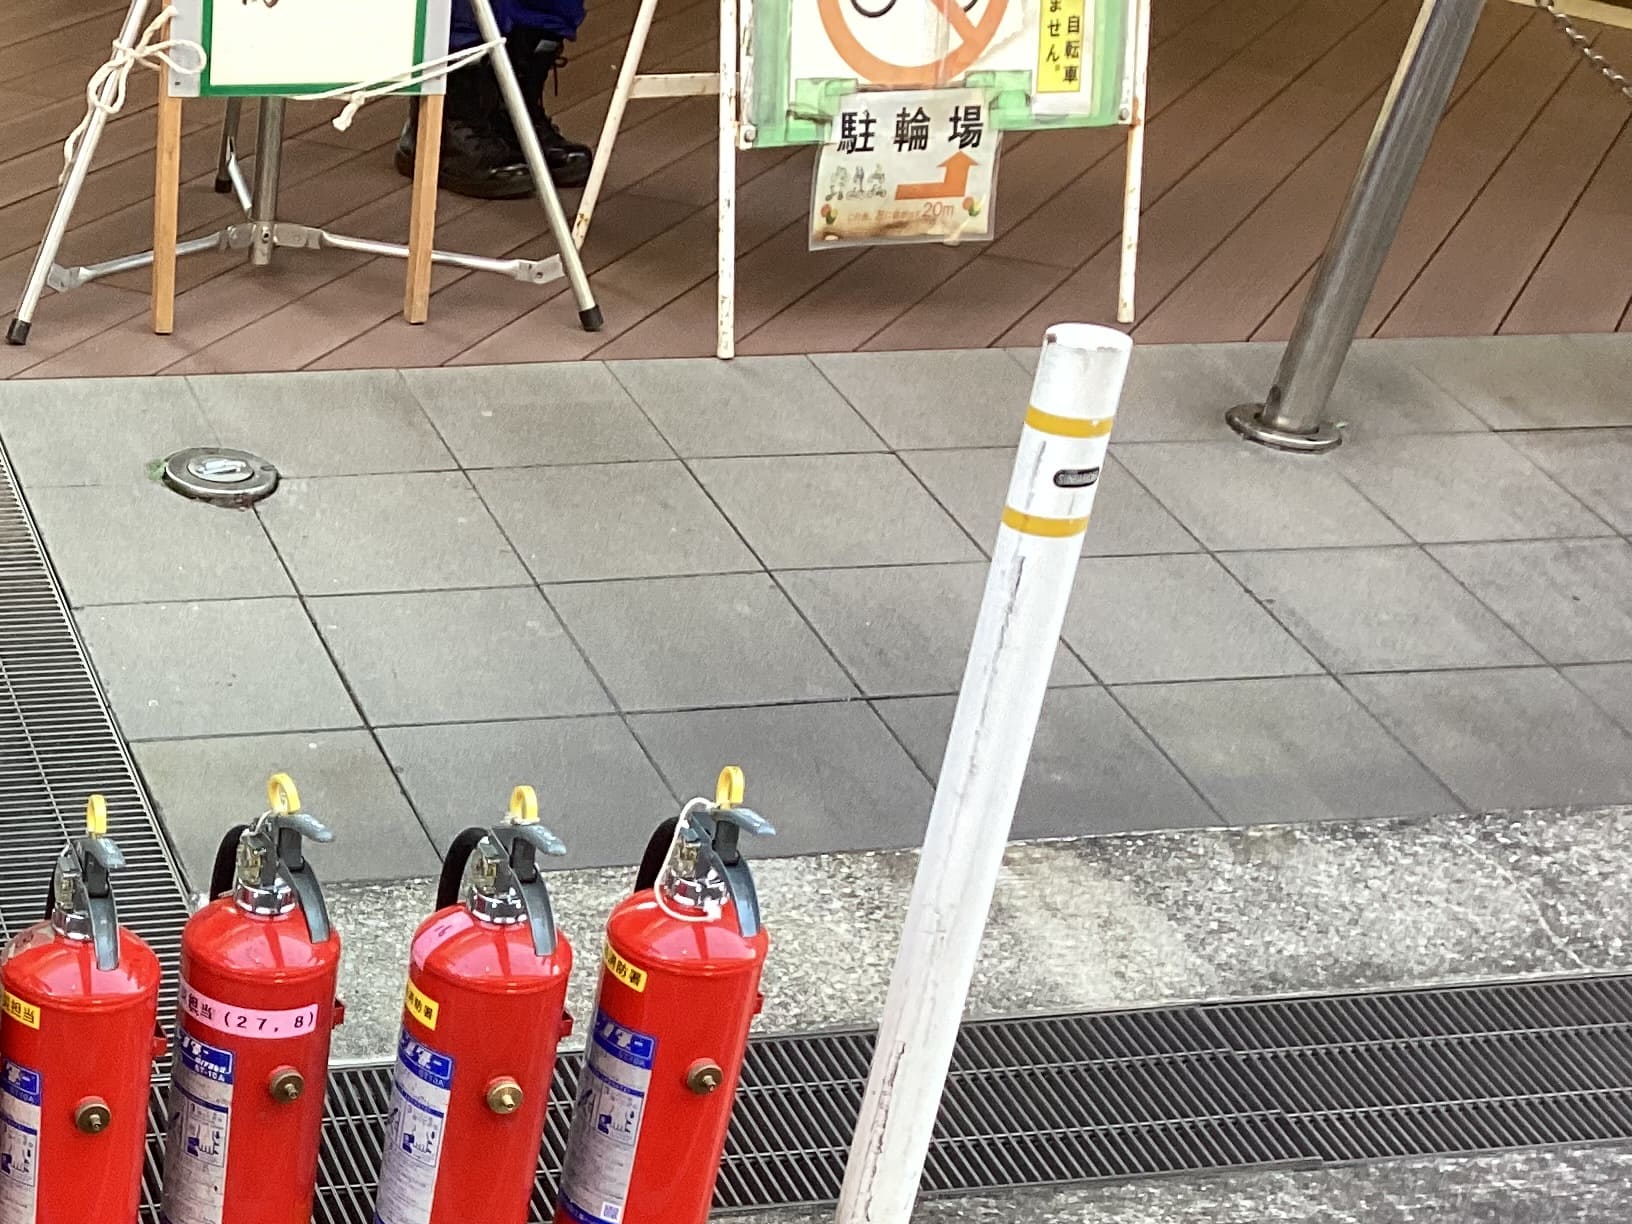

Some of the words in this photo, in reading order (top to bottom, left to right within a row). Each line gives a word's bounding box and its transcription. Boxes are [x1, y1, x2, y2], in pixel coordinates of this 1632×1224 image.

[1062, 14, 1080, 85] 自転車
[836, 105, 984, 155] 駐輪場
